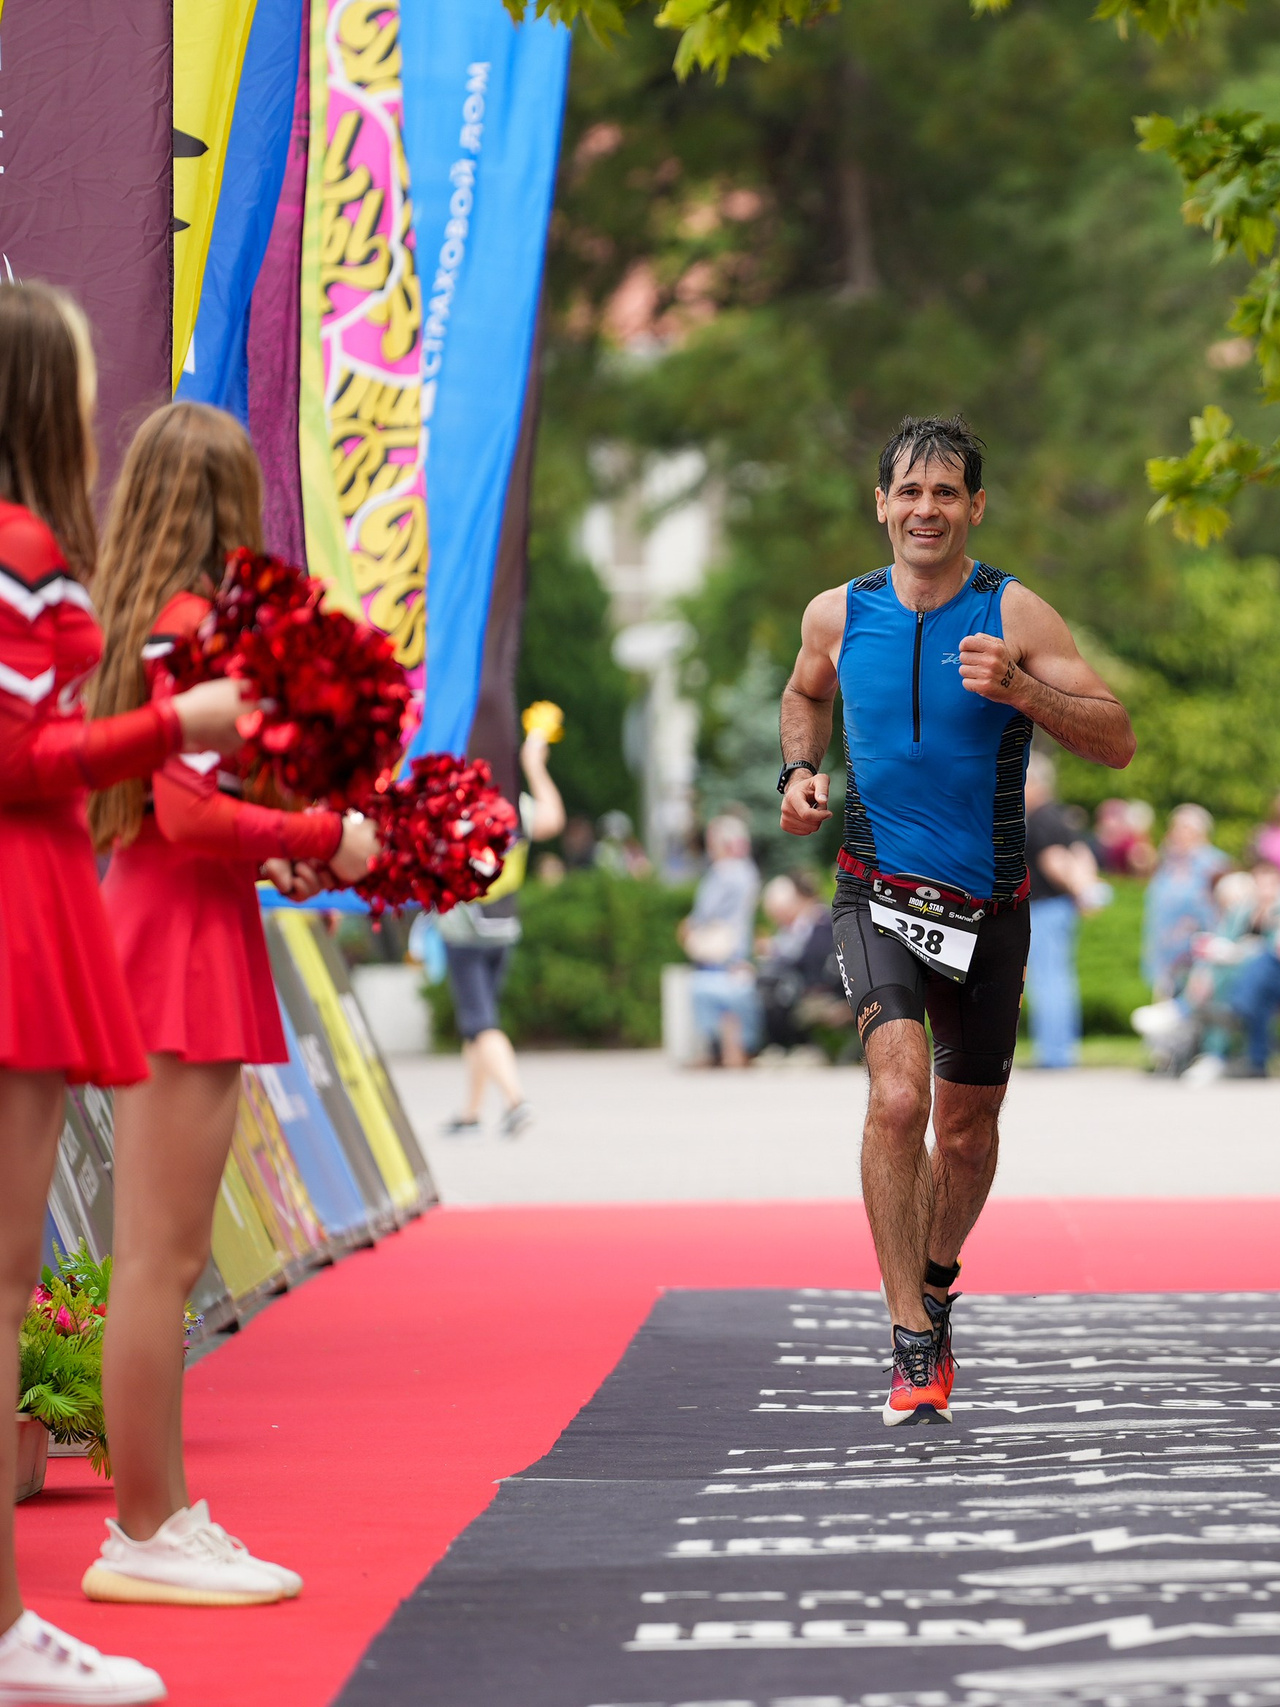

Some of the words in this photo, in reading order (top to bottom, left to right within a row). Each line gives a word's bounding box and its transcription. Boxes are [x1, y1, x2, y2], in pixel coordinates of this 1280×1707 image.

[459, 61, 491, 154] ДОМ
[1000, 660, 1016, 688] 228
[909, 896, 924, 907] IRON
[929, 902, 944, 914] STAR
[895, 917, 945, 955] 228
[722, 1453, 1008, 1473] IRON
[702, 1474, 1006, 1492] IRON
[676, 1529, 1017, 1554] IRON
[633, 1617, 1027, 1645] IRON
